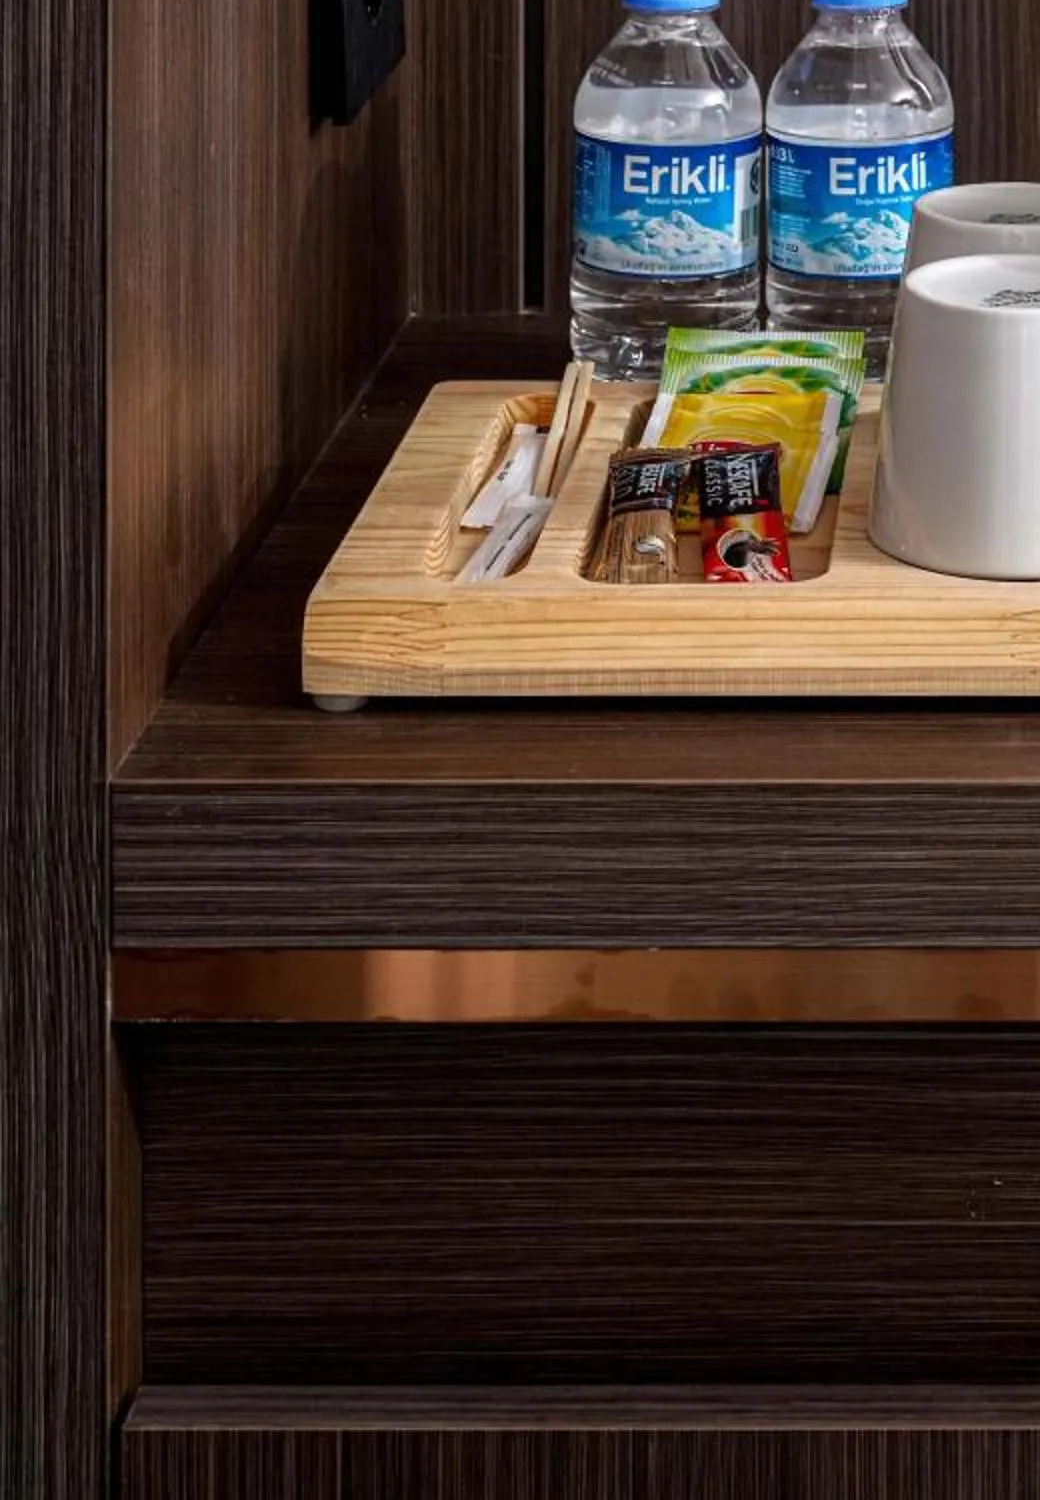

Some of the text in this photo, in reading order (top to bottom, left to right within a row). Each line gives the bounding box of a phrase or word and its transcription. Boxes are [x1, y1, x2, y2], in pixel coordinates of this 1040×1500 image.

[623, 154, 726, 195] Erikli
[829, 152, 926, 195] Erikli
[704, 459, 723, 507] CLASSIC
